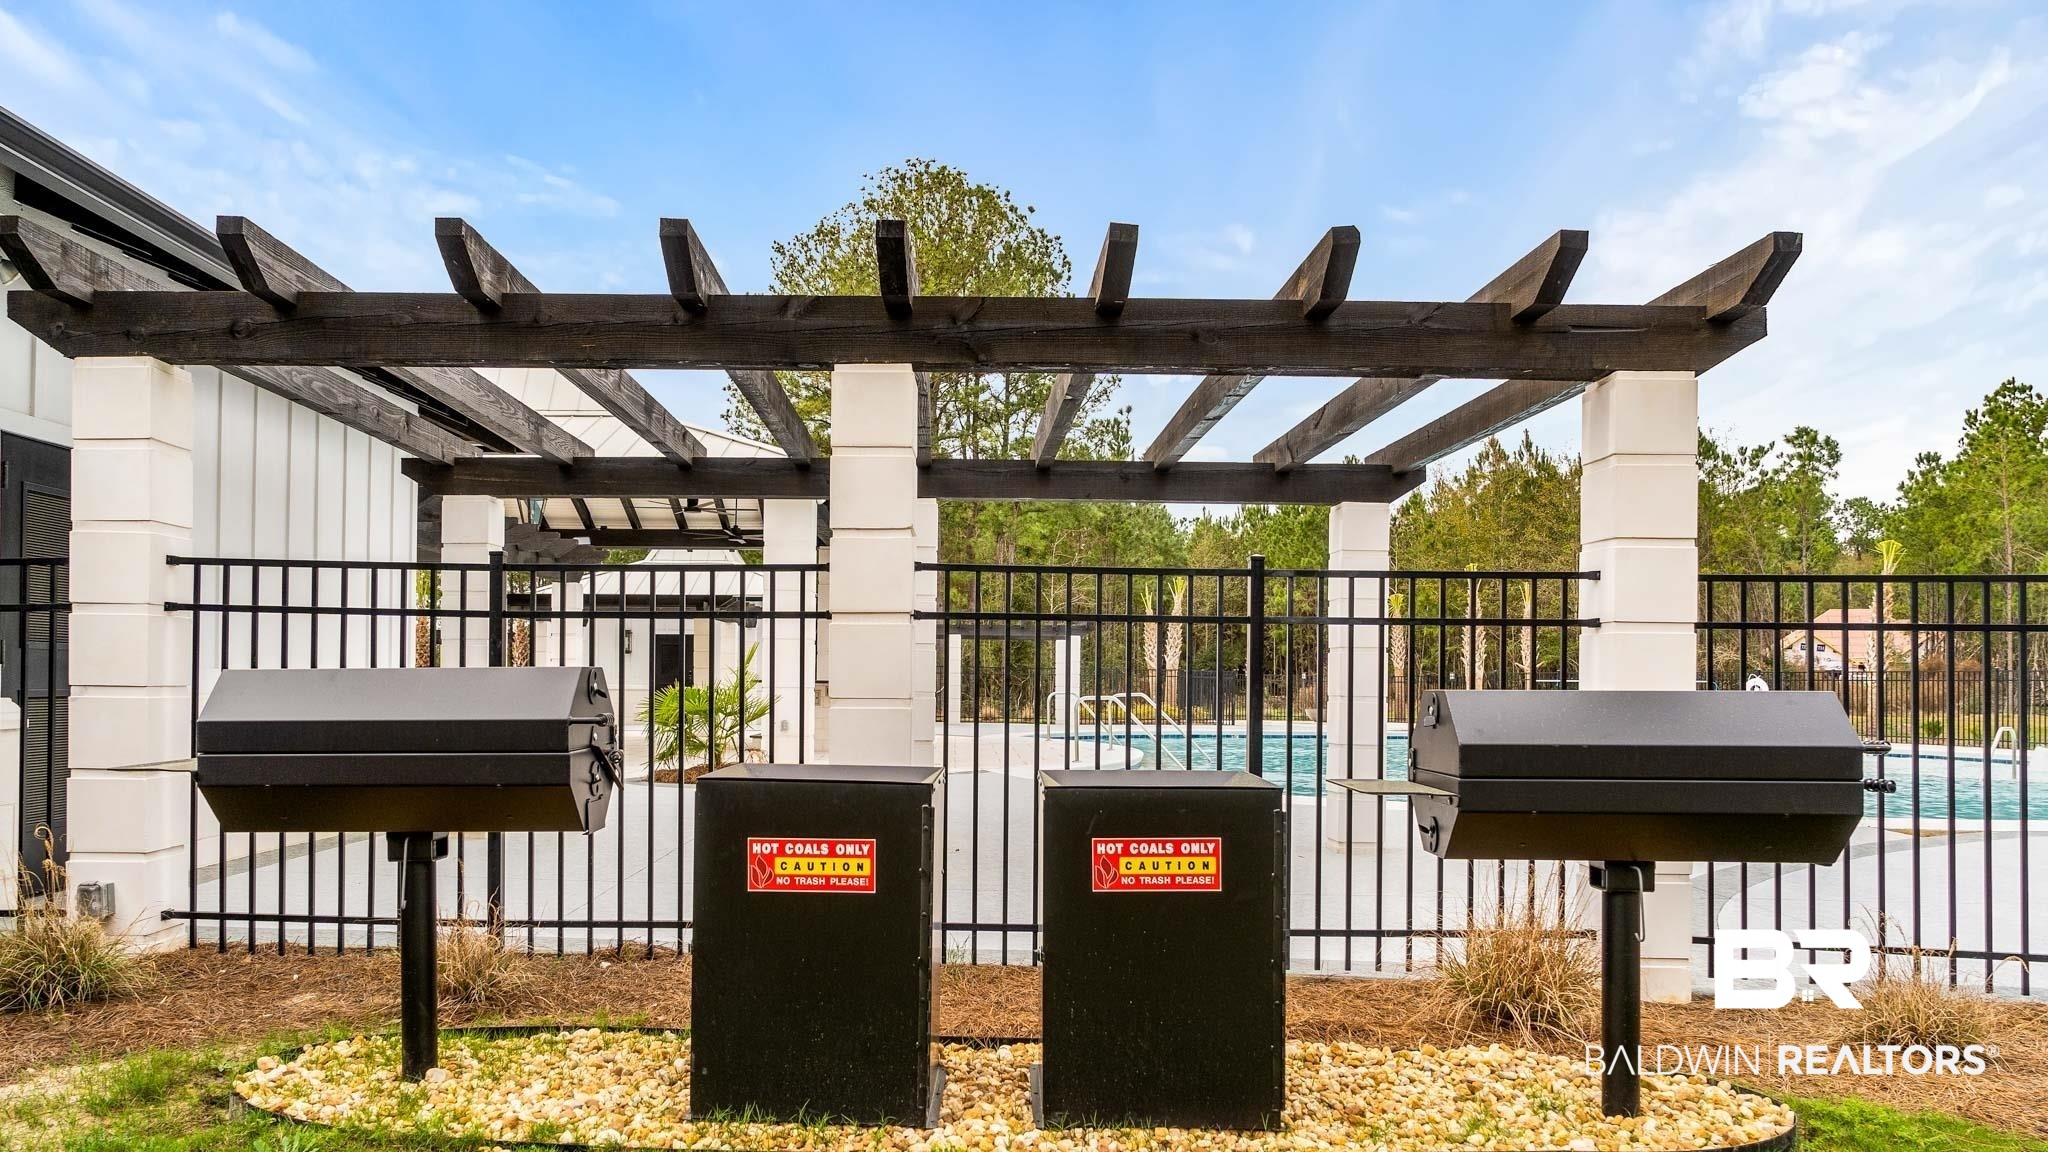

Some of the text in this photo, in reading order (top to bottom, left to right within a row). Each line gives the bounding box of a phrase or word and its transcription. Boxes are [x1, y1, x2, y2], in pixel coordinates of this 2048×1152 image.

[752, 843, 870, 855] HOT COALS ONLY
[1097, 843, 1215, 854] HOT COALS ONLY
[780, 862, 864, 871] CAUTION
[1125, 861, 1210, 870] CAUTION
[776, 877, 869, 886] NO TRASH PLEASE!
[1121, 876, 1214, 884] NO TRASH PLEASE!
